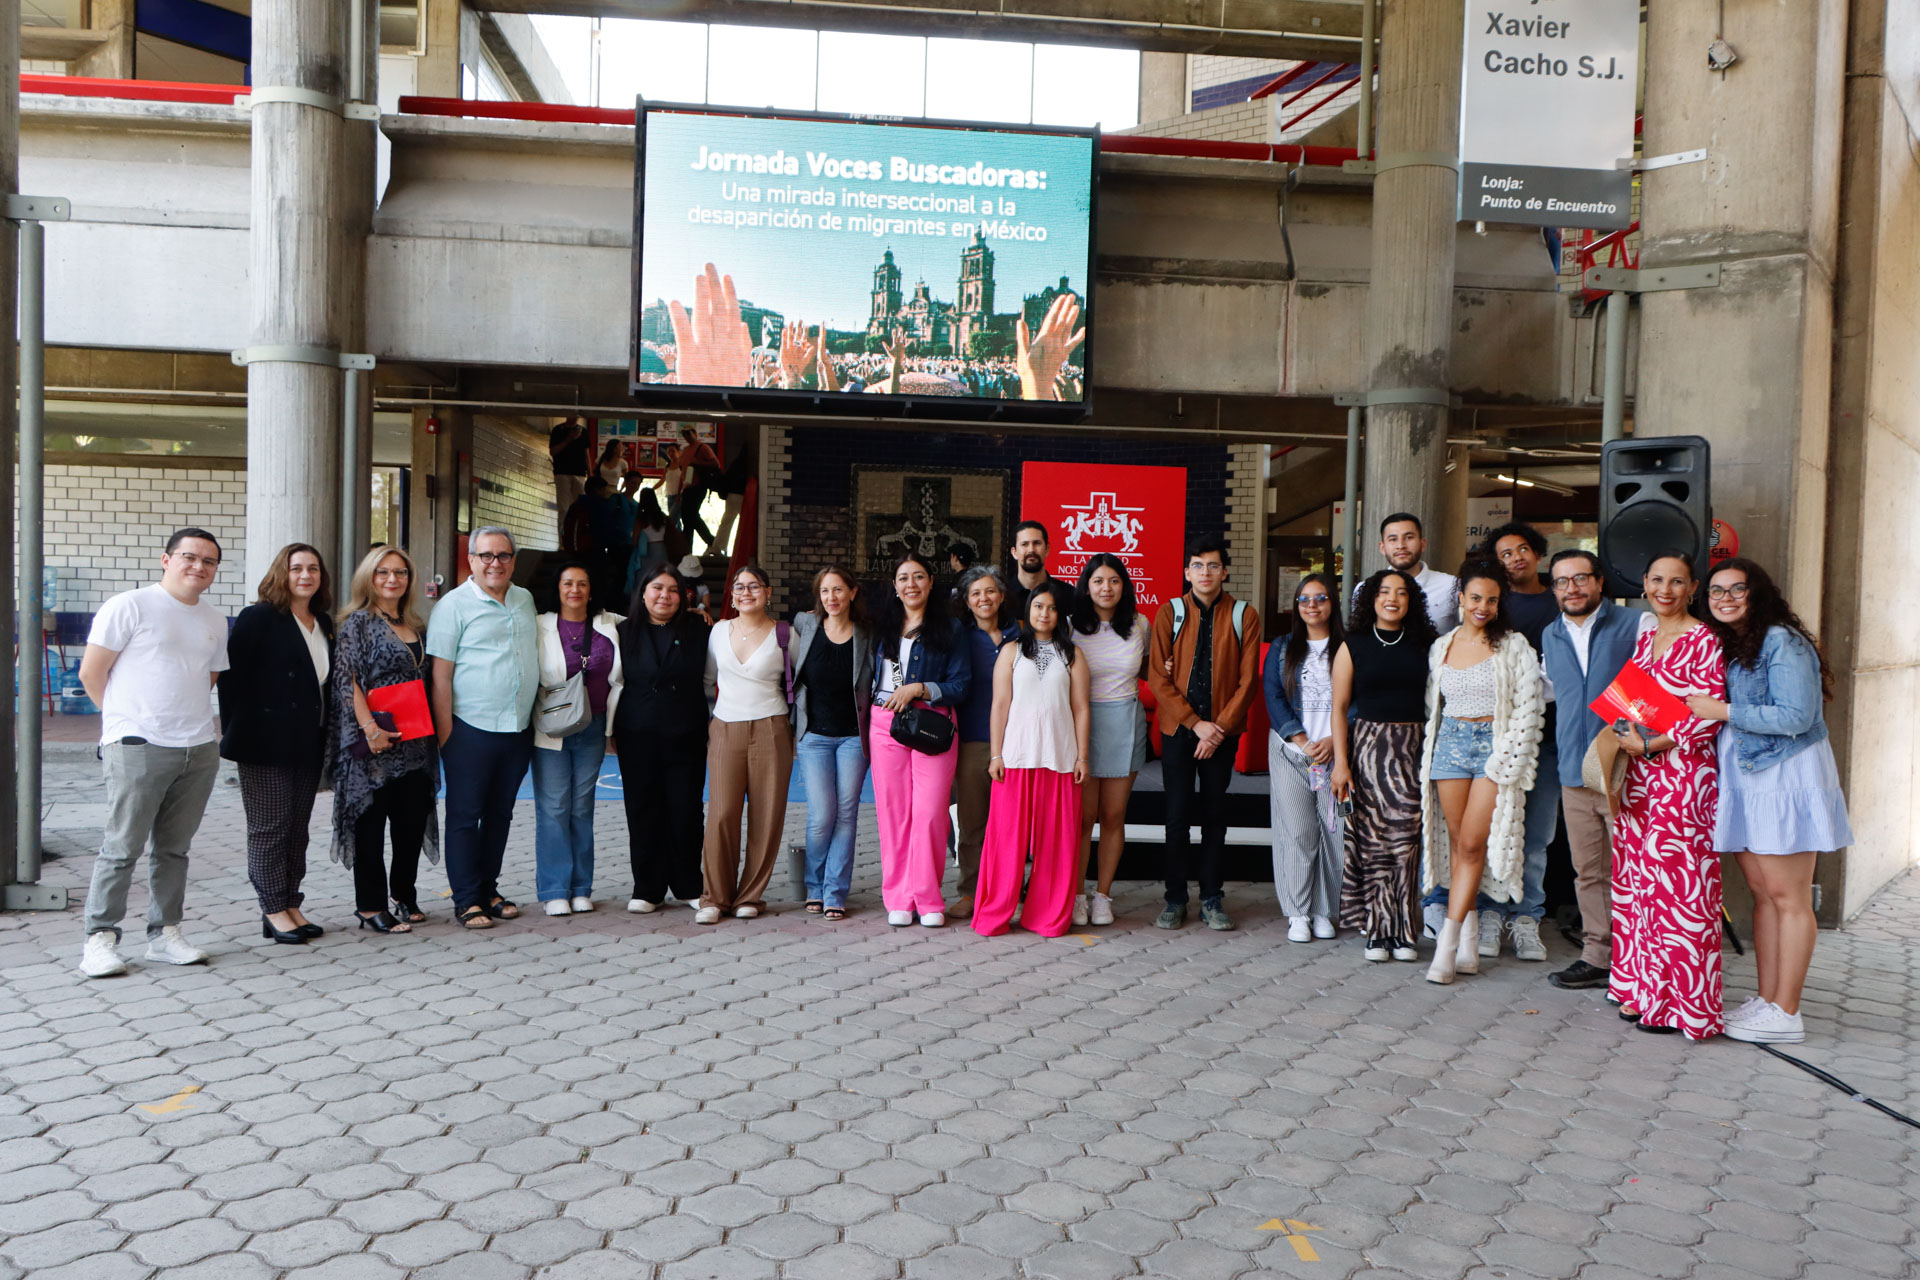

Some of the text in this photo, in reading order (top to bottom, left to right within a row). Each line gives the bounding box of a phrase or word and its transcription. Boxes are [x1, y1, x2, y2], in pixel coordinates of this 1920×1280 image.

[1485, 11, 1570, 39] Xavier
[1484, 49, 1624, 80] Cacho S.J.
[690, 145, 1047, 190] Jornada Voces Buscadoras:
[1481, 175, 1524, 192] Lonja:
[721, 181, 1016, 217] Una mirada interseccional a la
[1480, 194, 1617, 214] Punto de Encuentro
[687, 204, 1047, 242] desaparición de migrantes en México
[1057, 565, 1078, 575] NOS
[1073, 555, 1087, 564] LA
